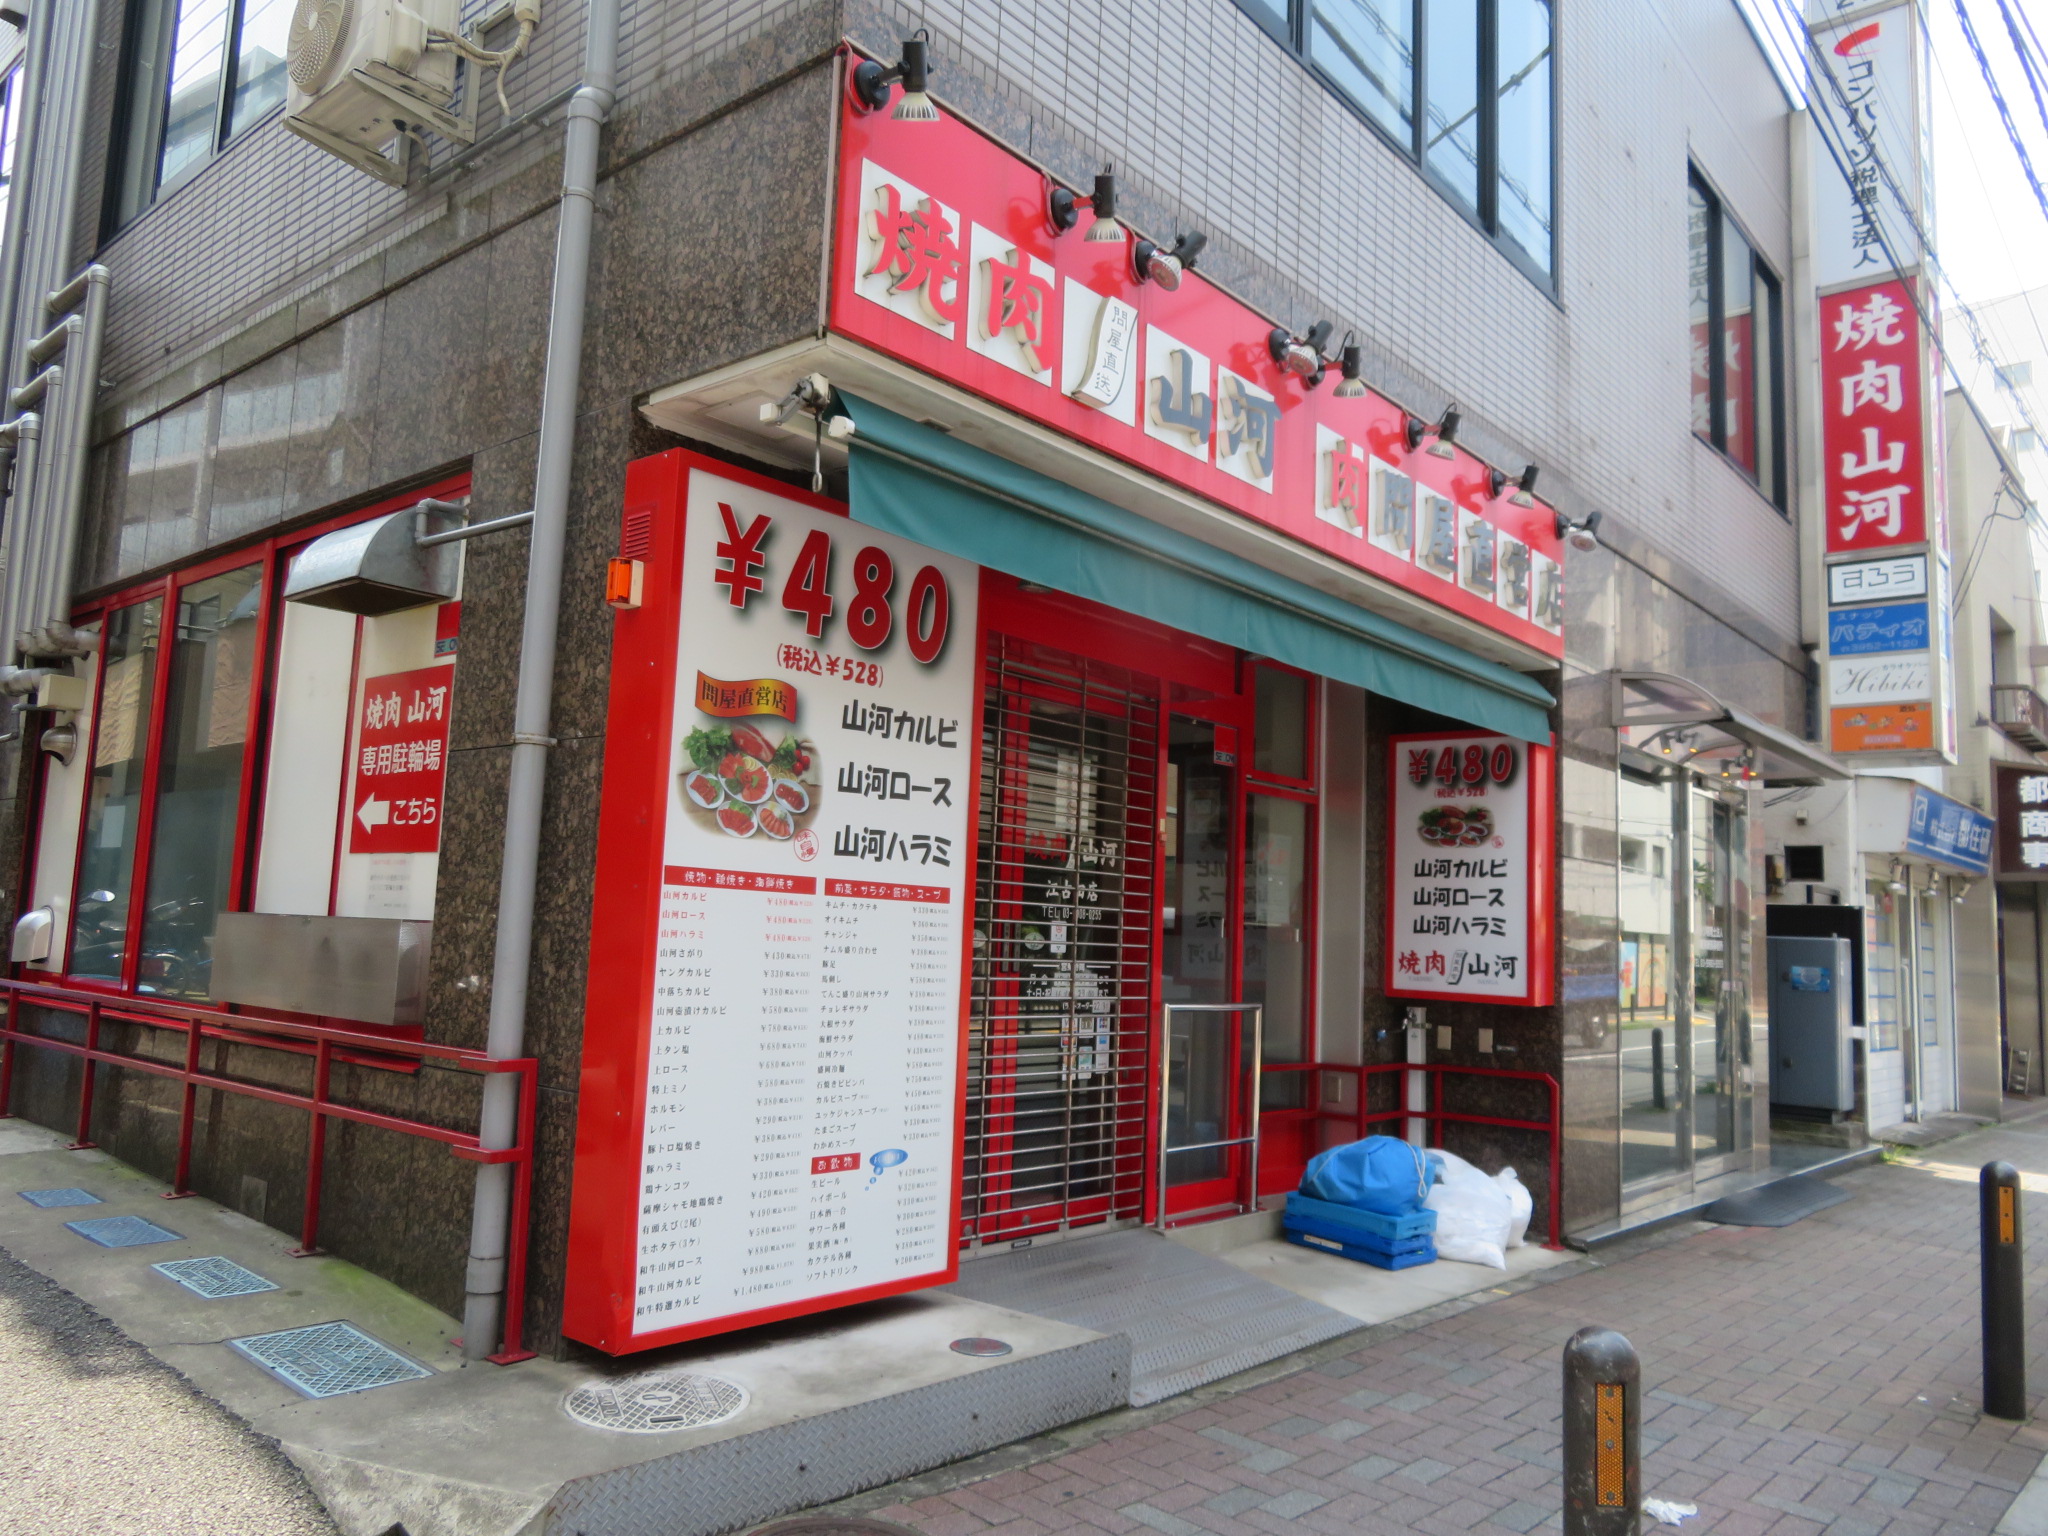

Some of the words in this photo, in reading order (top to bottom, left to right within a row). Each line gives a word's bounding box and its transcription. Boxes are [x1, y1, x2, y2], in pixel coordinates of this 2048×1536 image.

[863, 183, 1057, 374] 焼肉
[1151, 349, 1282, 479] 山河
[1095, 306, 1128, 398] 問屋直送
[1834, 293, 1911, 541] 焼肉山河
[714, 501, 950, 664] ¥480
[777, 643, 884, 688] (税込¥528)
[1835, 664, 1928, 695] Hibiki
[701, 678, 788, 715] 問屋直営店
[366, 691, 402, 731] 焼肉
[407, 686, 447, 724] 山河
[840, 698, 958, 749] 山河カルビ
[361, 739, 442, 777] 専用駐輪場
[1408, 743, 1513, 784] ¥480
[837, 761, 954, 808] 山河ロース
[393, 797, 437, 826] こちら
[833, 823, 953, 868] 山河ハラミ
[1414, 858, 1508, 878] 山河カルビ
[664, 891, 707, 902] 山河カルビ
[1414, 887, 1506, 907] 山河ロース
[662, 910, 706, 920] 山河ロース
[824, 916, 859, 924] オイキムチ
[1413, 915, 1506, 936] 山河ハラミ
[661, 930, 704, 940] 山河ハラミ
[824, 930, 858, 940] チャンジャ
[660, 949, 703, 958] 山河さがり
[1398, 950, 1446, 976] 焼肉
[1468, 952, 1518, 979] 山河
[659, 968, 712, 978] ヤングカルビ
[658, 986, 711, 997] 中落ちカルビ
[820, 1004, 868, 1014] チョレギサラダ
[656, 1026, 691, 1036] 上カルビ
[654, 1045, 690, 1056] 上タン塩
[654, 1064, 688, 1075] 上ロース
[652, 1084, 687, 1094] 特上ミノ
[650, 1104, 686, 1114] ホルモン
[650, 1124, 676, 1134] レバー
[814, 1124, 856, 1135] たまごスープ
[648, 1140, 702, 1154] 豚トロ塩焼き
[813, 1138, 856, 1150] わかめスープ
[646, 1162, 682, 1174] 豚ハラミ
[644, 1181, 690, 1194] 鶏ナンコツ
[812, 1177, 840, 1188] 生ビール
[810, 1192, 847, 1203] ハイボール
[640, 1256, 702, 1276] 和牛山河ロース
[806, 1265, 858, 1282] ソフトドリンク
[638, 1275, 702, 1296] 和牛山河カルビ
